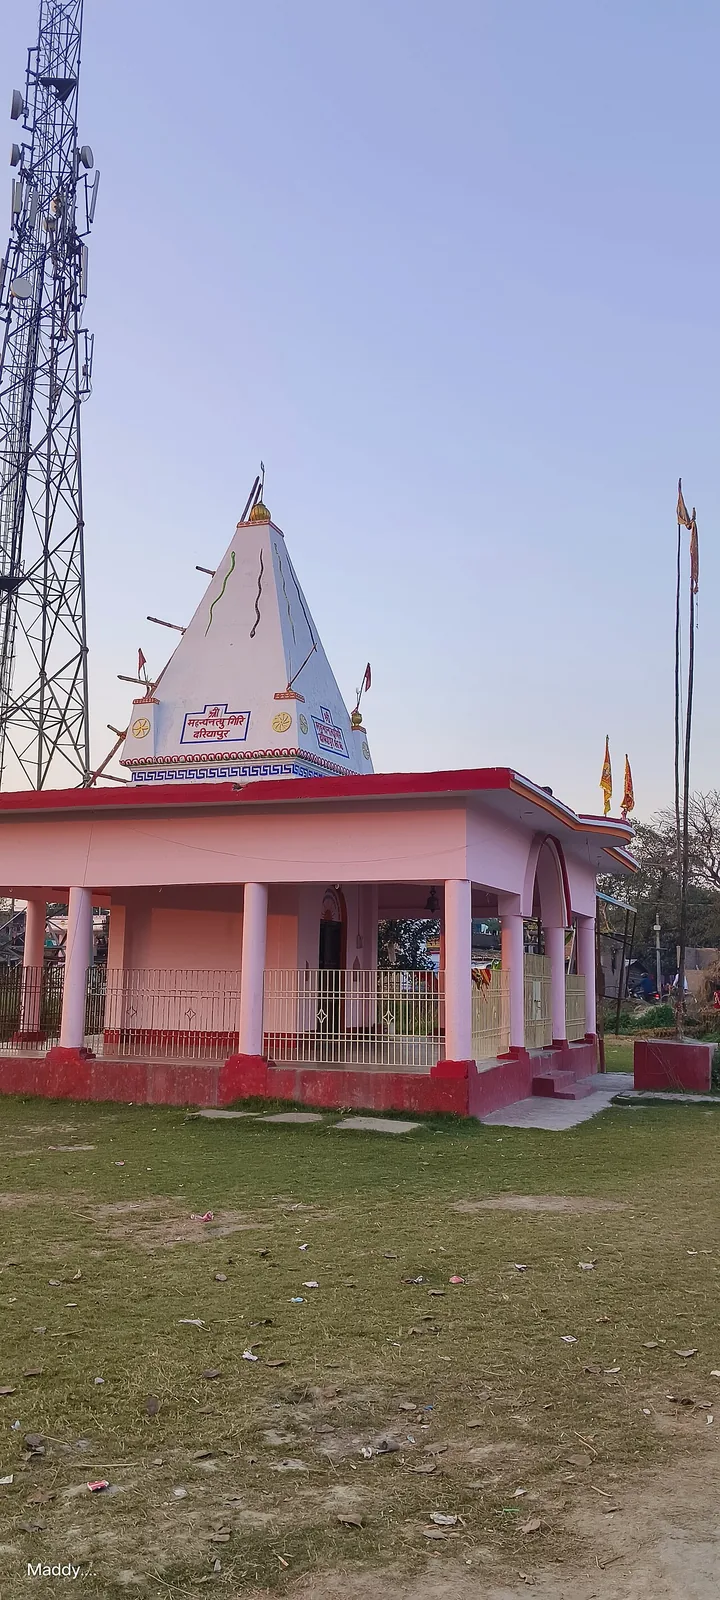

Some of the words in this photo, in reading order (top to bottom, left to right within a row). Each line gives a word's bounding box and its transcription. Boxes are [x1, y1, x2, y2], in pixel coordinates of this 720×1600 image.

[208, 706, 220, 718] श्री
[227, 715, 246, 726] गिरि
[193, 728, 230, 740] दरियापुर
